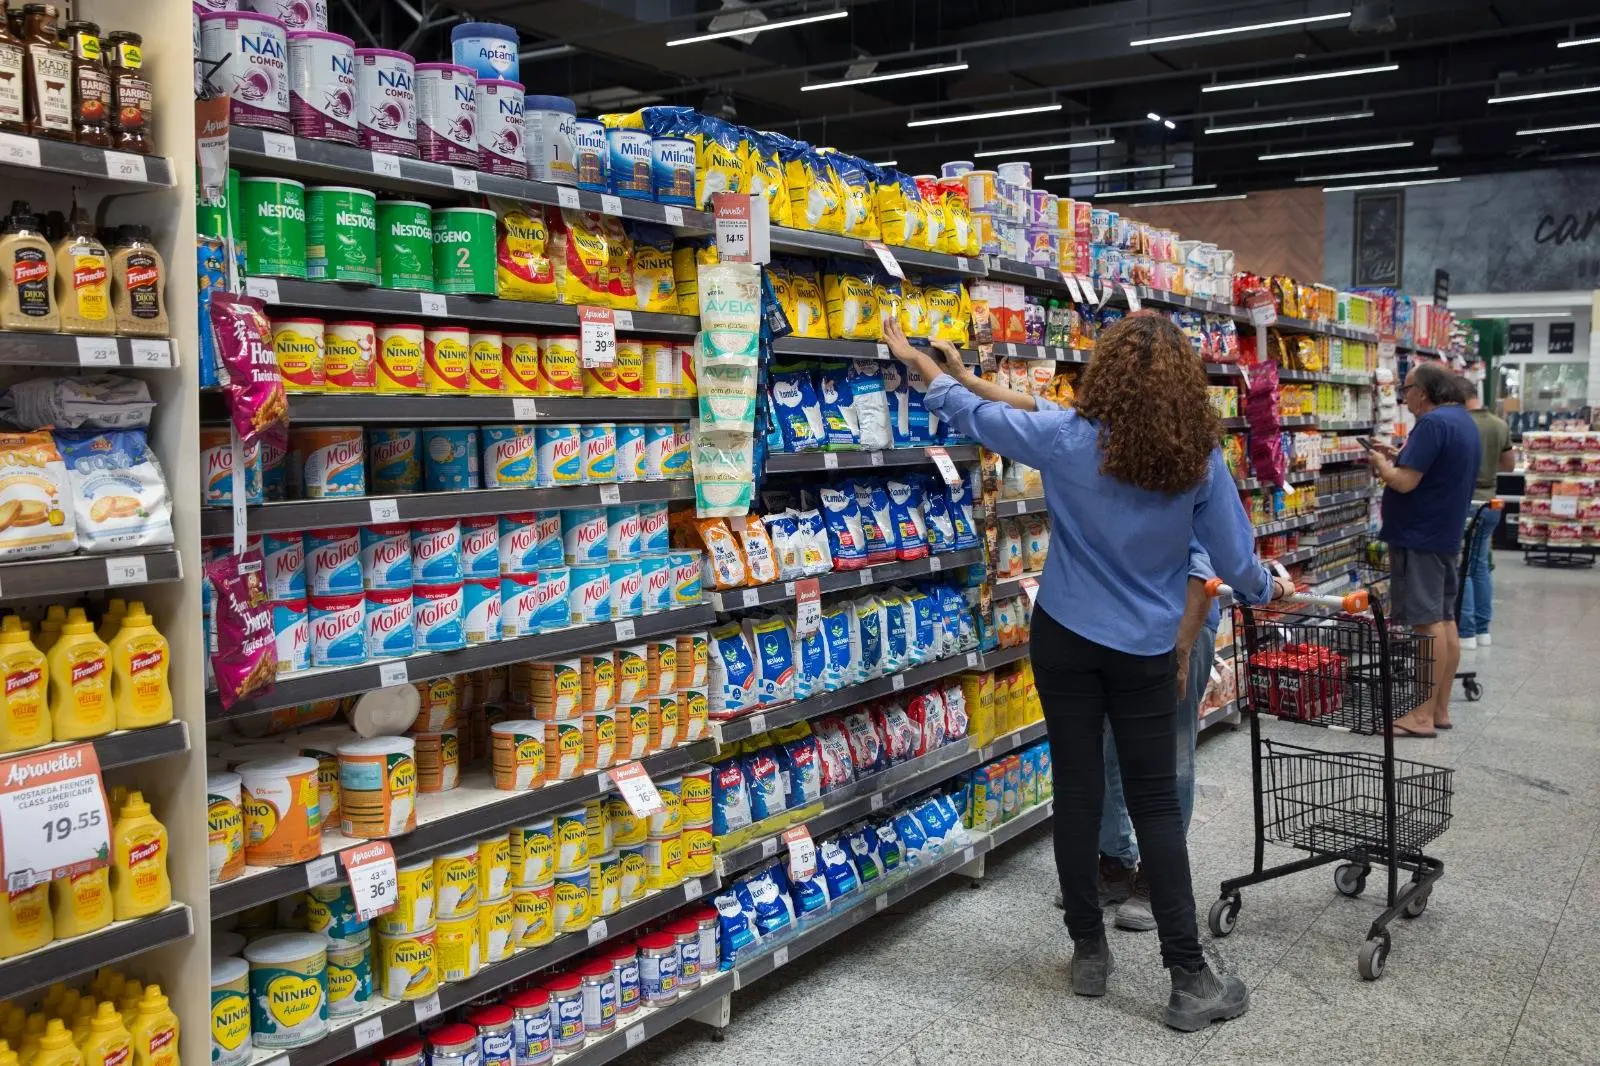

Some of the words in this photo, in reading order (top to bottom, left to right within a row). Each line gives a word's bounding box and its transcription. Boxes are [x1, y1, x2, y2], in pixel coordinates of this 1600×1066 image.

[38, 58, 69, 73] MADE
[82, 88, 100, 98] SAUCE
[120, 96, 138, 106] SAUCE
[119, 164, 133, 175] 20
[508, 223, 545, 241] NINHO
[456, 247, 471, 269] 2
[15, 265, 48, 281] French's
[127, 269, 158, 284] French's
[24, 290, 46, 300] DIJON
[704, 300, 755, 314] AVEIA
[277, 342, 316, 354] NINHO
[386, 347, 420, 359] NINHO
[594, 340, 615, 352] 39.99
[94, 349, 107, 360] 23
[146, 351, 159, 362] 22
[545, 355, 576, 365] NINHO
[617, 357, 642, 367] NINHO
[495, 434, 534, 463] Molico
[413, 532, 456, 560] Molico
[315, 540, 360, 574] Molico
[123, 567, 135, 578] 19
[371, 603, 412, 638] Molico
[416, 598, 459, 630] Molico
[315, 610, 361, 645] Molico
[133, 651, 161, 671] French's
[73, 660, 105, 680] French's
[7, 671, 41, 691] French's
[136, 684, 161, 695] YELLOW
[12, 704, 39, 717] YELLOW
[3, 748, 83, 788] Aproveite!
[13, 785, 58, 801] MOSTARDA
[59, 777, 95, 792] FRENCHS
[18, 797, 47, 810] CLASS
[48, 786, 93, 804] AMERICANA
[48, 802, 70, 813] 396G
[41, 808, 101, 844] 19.55
[130, 840, 161, 863] French's
[556, 890, 586, 902] NINHO
[514, 900, 548, 913] NINHO
[395, 947, 432, 963] NINHO
[273, 984, 317, 1005] NINHO
[284, 1002, 311, 1015] Adulto
